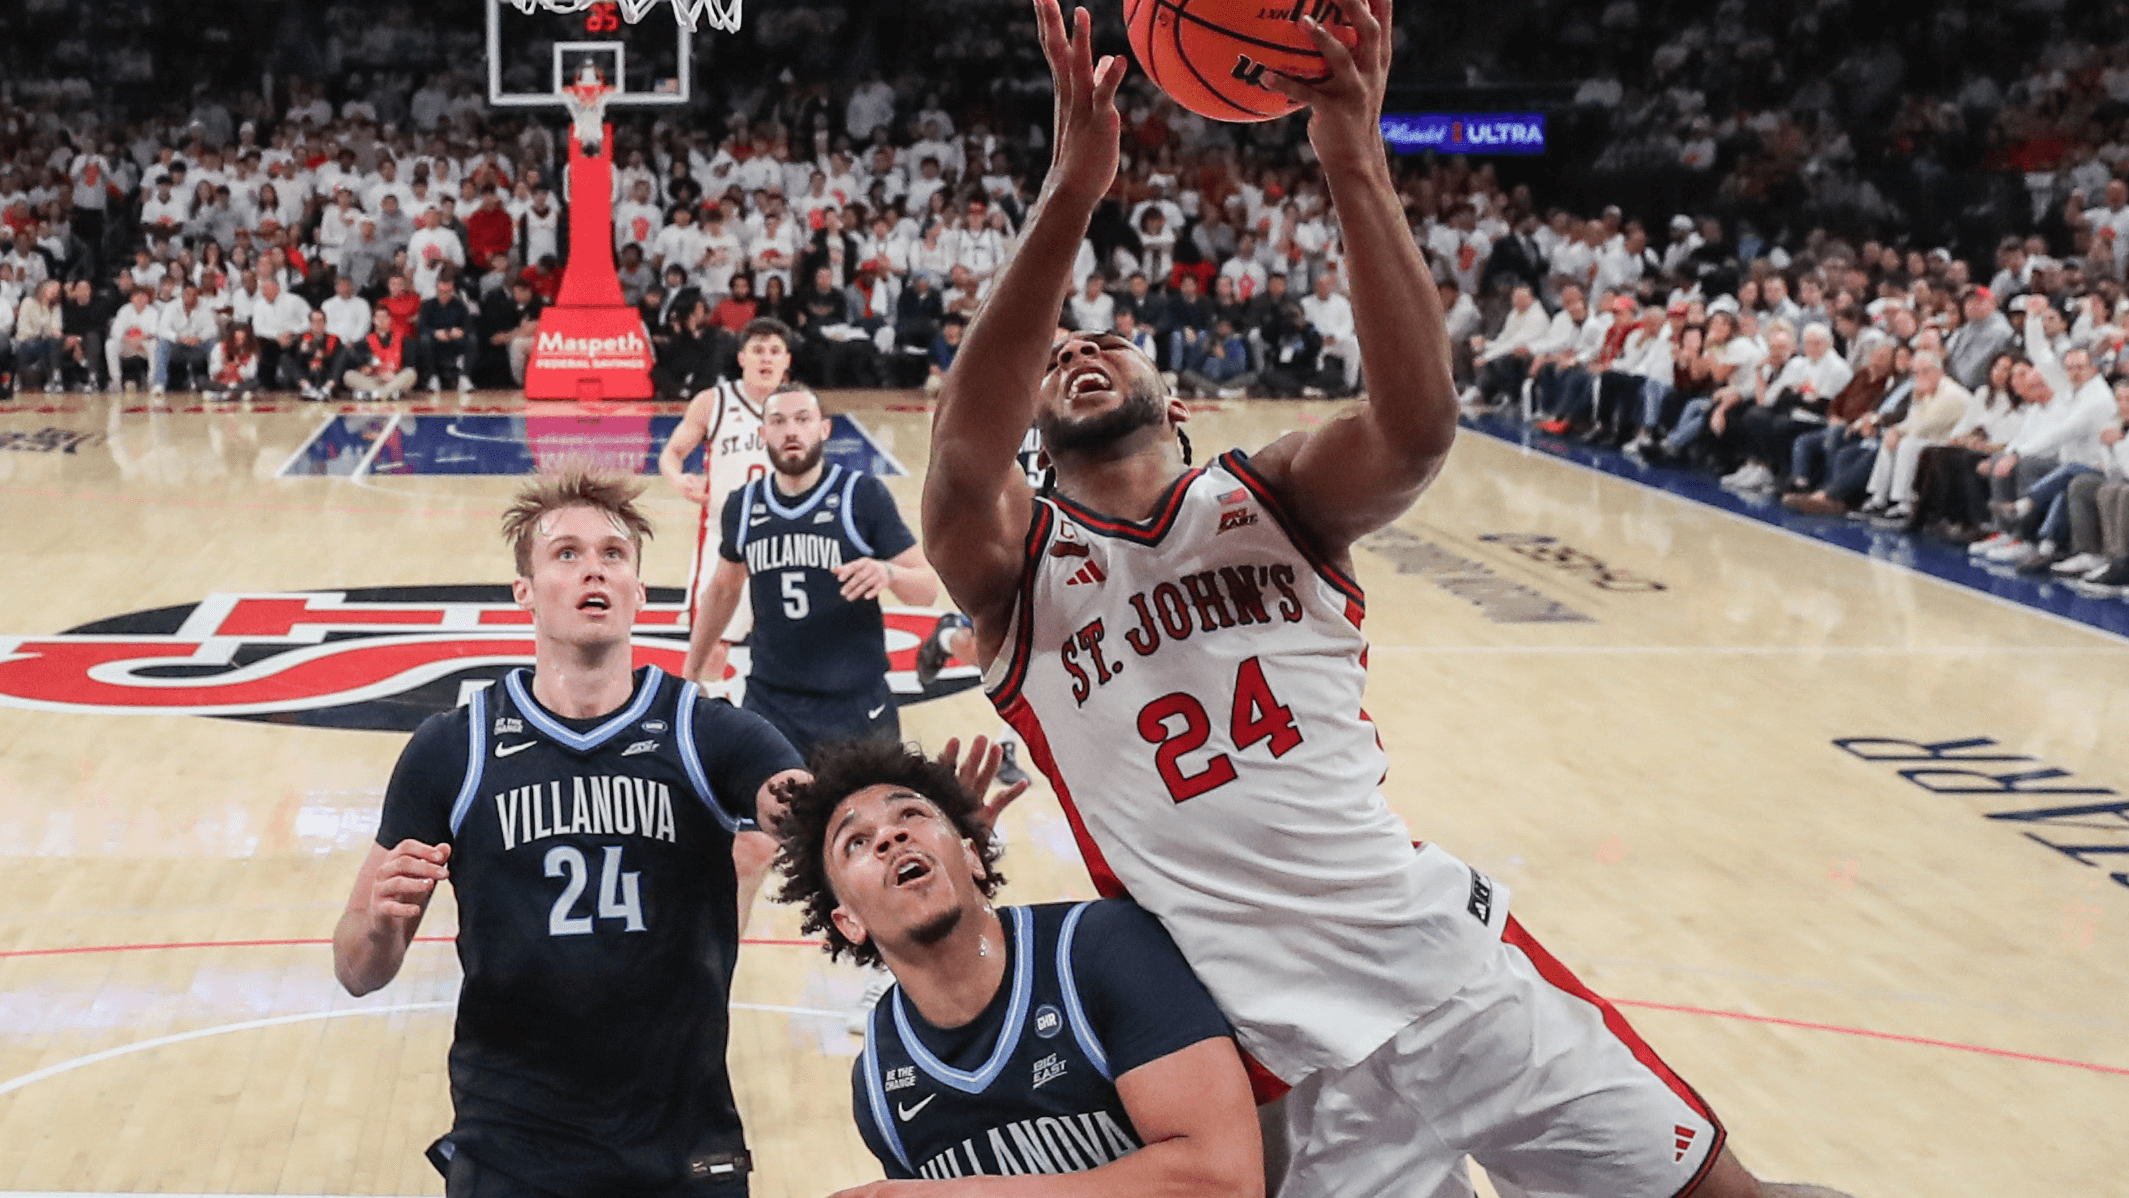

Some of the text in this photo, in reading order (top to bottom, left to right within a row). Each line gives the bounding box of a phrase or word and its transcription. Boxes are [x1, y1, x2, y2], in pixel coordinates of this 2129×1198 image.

[1467, 123, 1543, 145] ULTRA
[538, 331, 644, 358] Maspeth
[746, 533, 843, 575] VILLANOVA
[781, 572, 810, 620] 5
[1061, 617, 1123, 708] ST.
[1125, 564, 1303, 656] JOHN'S
[1137, 655, 1304, 804] 24
[495, 775, 676, 851] VILLANOVA
[1831, 736, 2129, 888] TARR
[544, 845, 648, 936] 24
[897, 1065, 914, 1078] THE
[1033, 1052, 1057, 1072] BIG
[1033, 1060, 1067, 1083] EAST
